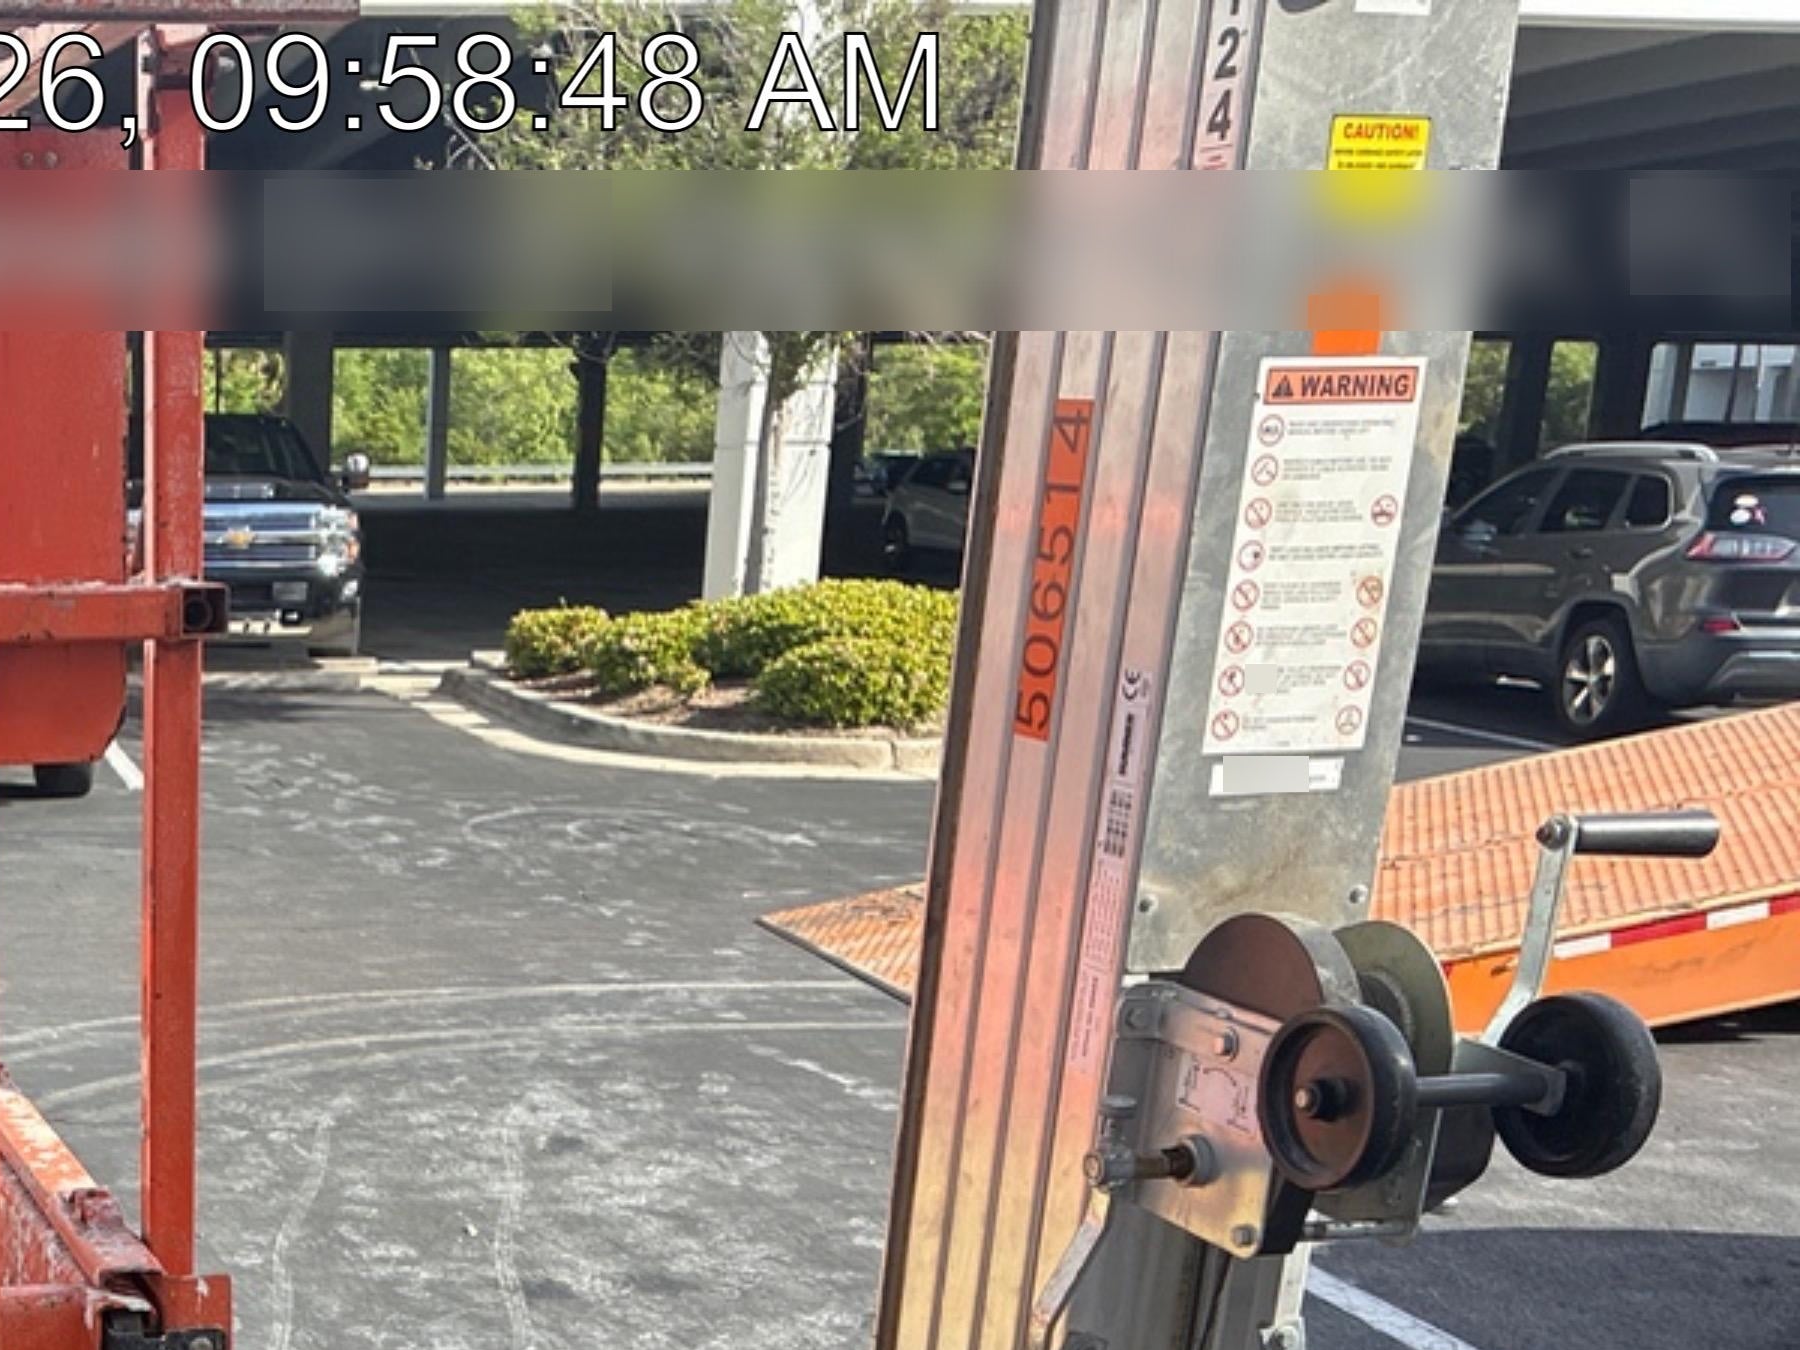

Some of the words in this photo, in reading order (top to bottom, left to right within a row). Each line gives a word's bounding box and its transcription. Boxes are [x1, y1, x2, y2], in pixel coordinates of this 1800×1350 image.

[1206, 0, 1241, 141] 24
[1301, 374, 1409, 397] WARNING
[1017, 408, 1092, 730] 506514
